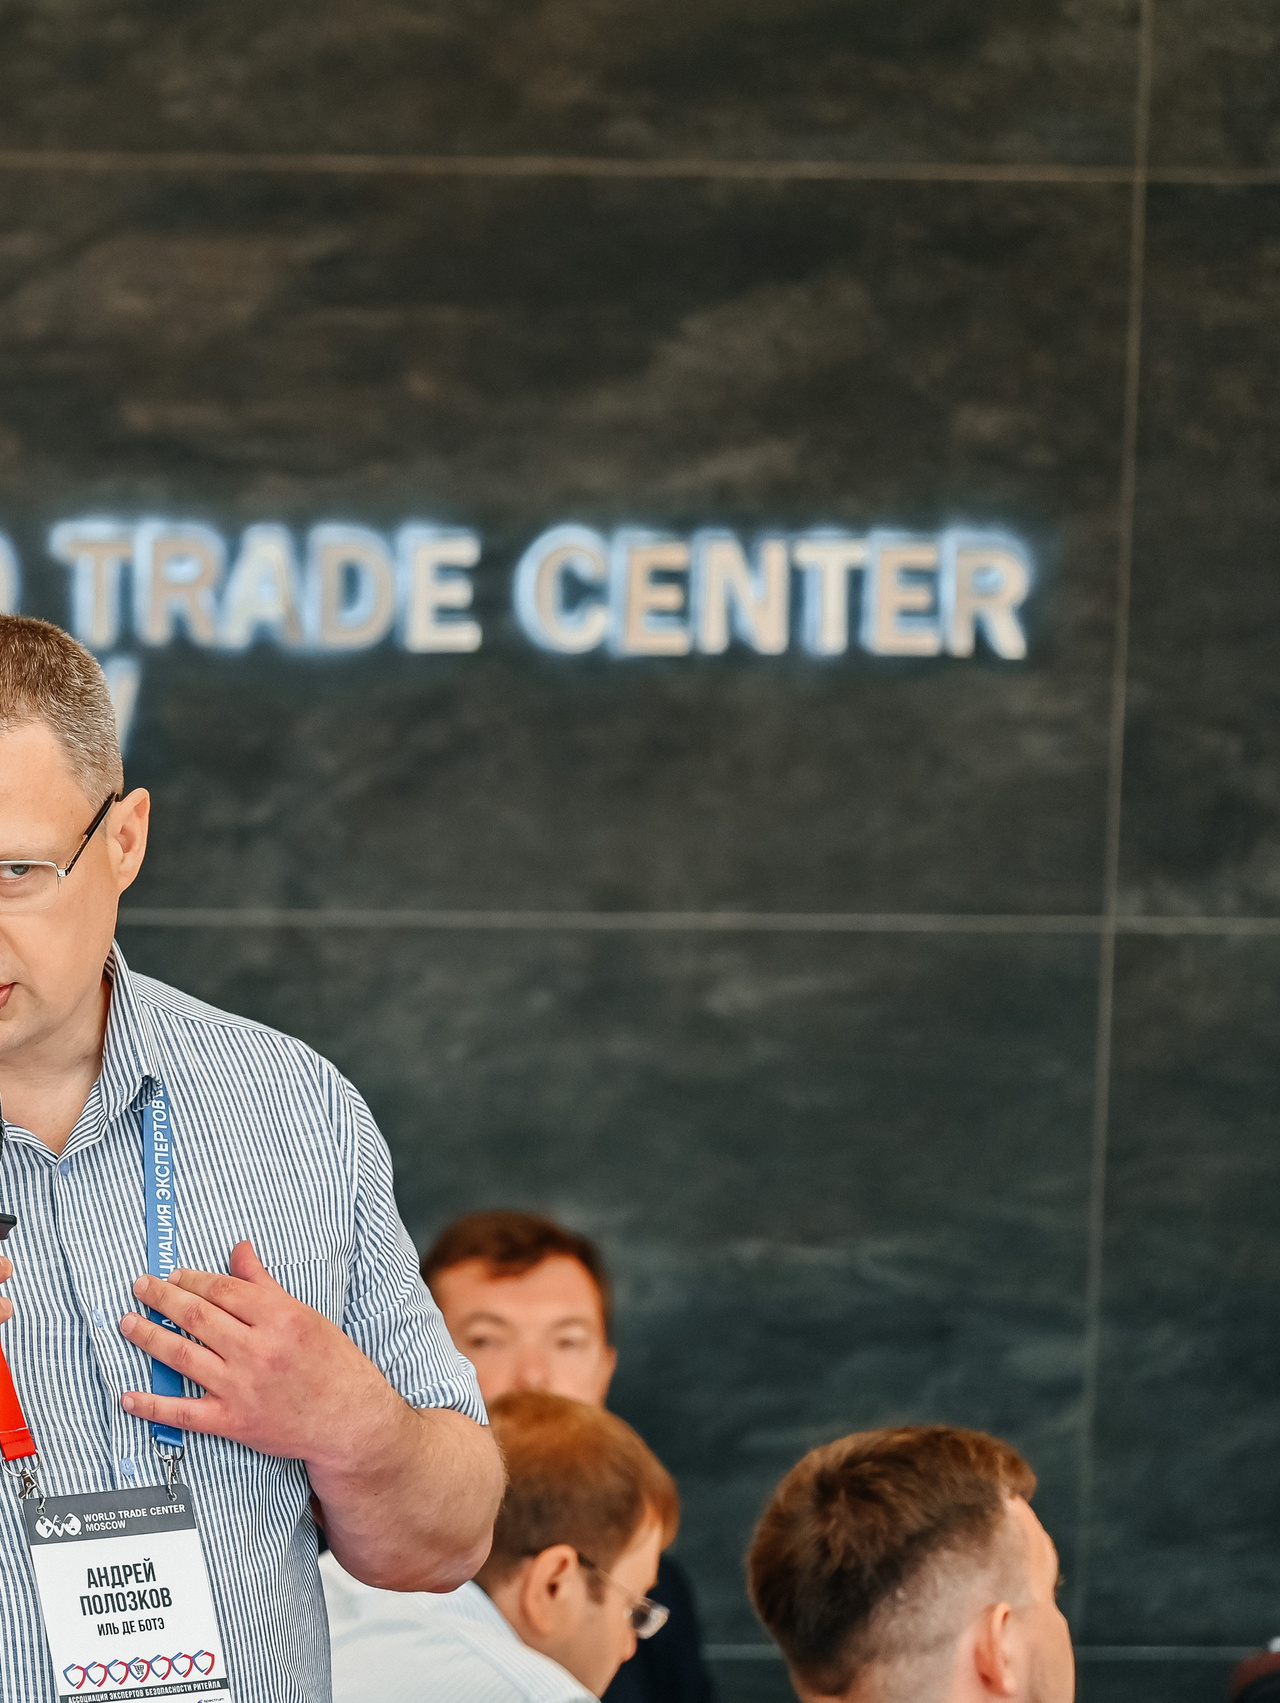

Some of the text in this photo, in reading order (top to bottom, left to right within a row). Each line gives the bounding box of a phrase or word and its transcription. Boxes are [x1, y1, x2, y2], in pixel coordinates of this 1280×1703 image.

[48, 517, 483, 652] TRADE
[513, 522, 1033, 659] CENTER
[151, 1099, 172, 1201] ЭКСПЕРТОВ
[83, 1504, 186, 1523] WORLD TRADE CENTER
[85, 1519, 126, 1532] MOSCOW
[87, 1557, 157, 1589] АНДРЕЙ
[79, 1587, 173, 1616] ПОЛОЗКОВ
[97, 1617, 165, 1636] ИЛЬ ДЕ БОТЭ
[109, 1689, 144, 1700] ЭКСПЕРТОВ
[144, 1684, 193, 1697] БЕЗОПАСНОСТИ
[193, 1680, 221, 1691] РИТЕЙЛА
